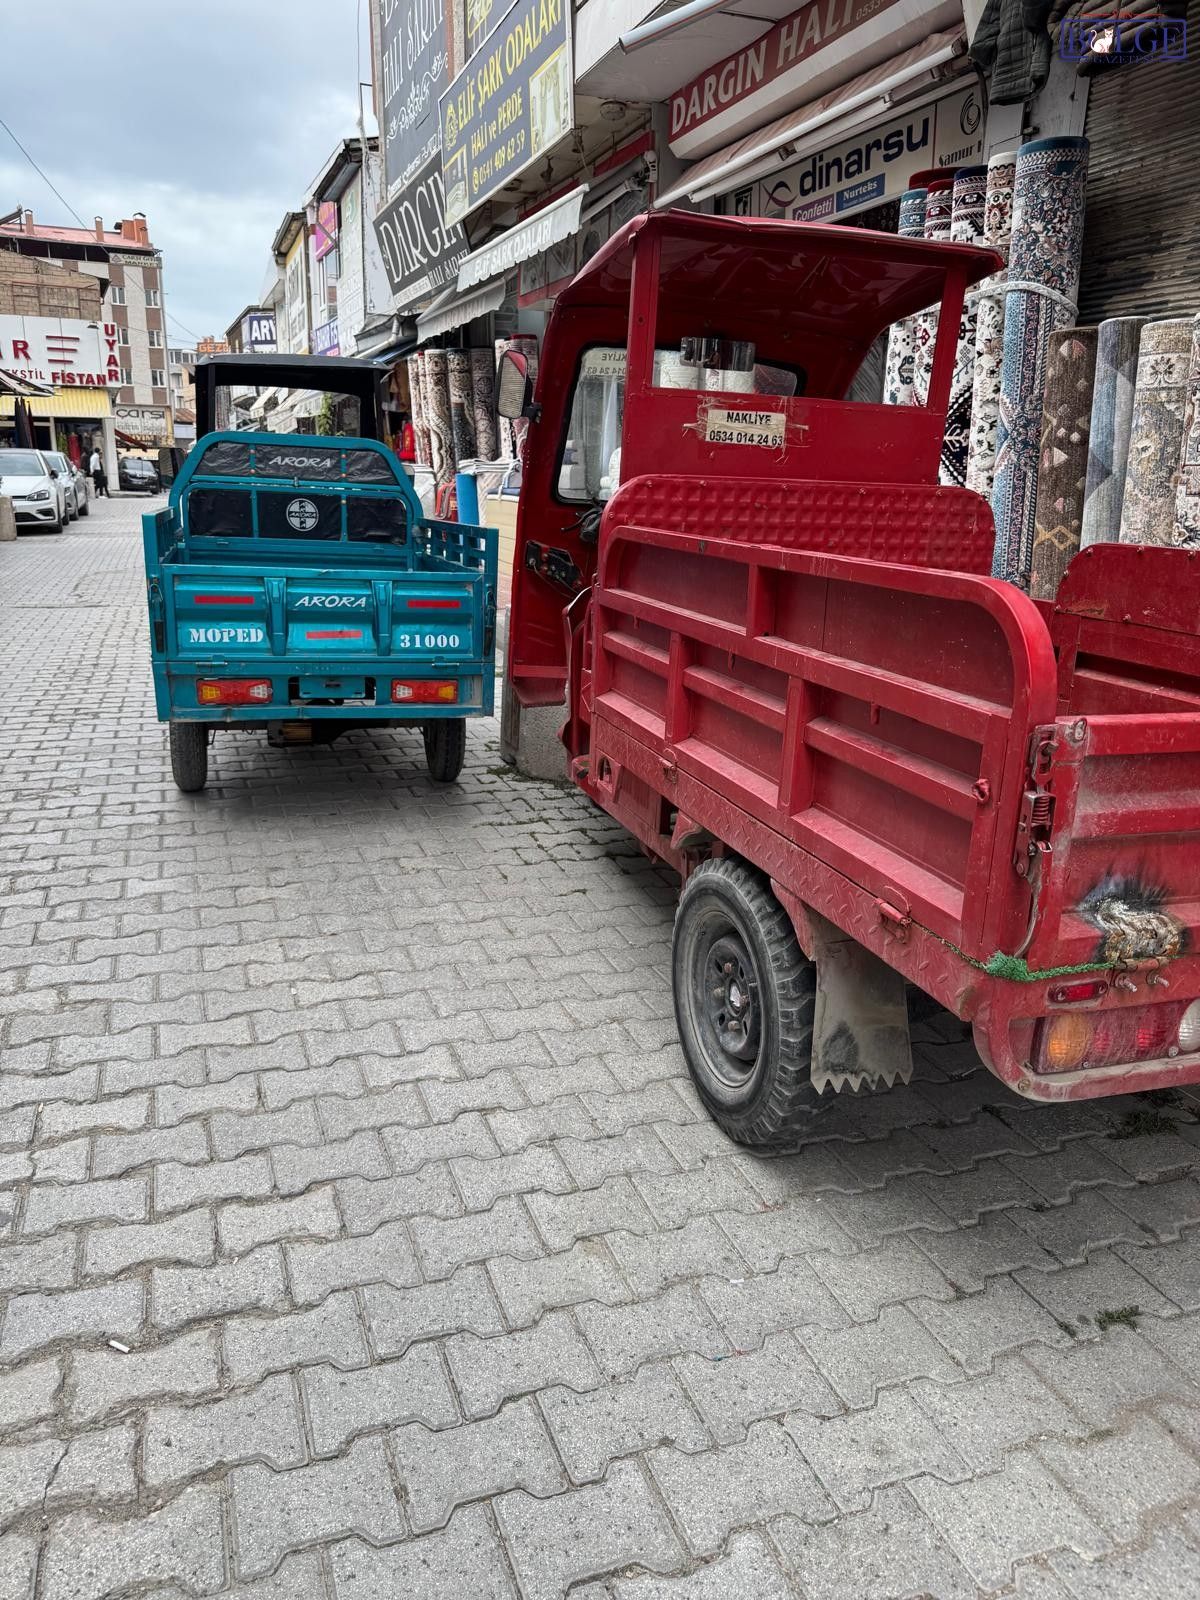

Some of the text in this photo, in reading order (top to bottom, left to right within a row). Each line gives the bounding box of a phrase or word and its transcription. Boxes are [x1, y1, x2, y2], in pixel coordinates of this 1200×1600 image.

[671, 39, 768, 136] DARGIN
[776, 0, 852, 69] HALI
[458, 75, 475, 130] ELİF
[478, 45, 503, 118] ŞARK
[471, 121, 488, 160] HALI
[498, 86, 523, 135] PERDE
[799, 116, 929, 198] dinarsu
[843, 181, 879, 201] Nurteks
[795, 197, 833, 222] Confetti
[104, 324, 119, 382] UYAR
[51, 369, 107, 386] FİSTAN
[726, 411, 772, 425] NAKLİYE
[709, 430, 783, 447] 0534 014 24 63
[268, 455, 332, 468] ARORA
[295, 594, 367, 609] ARORA
[189, 628, 264, 643] MOPED
[400, 634, 460, 649] 31000
